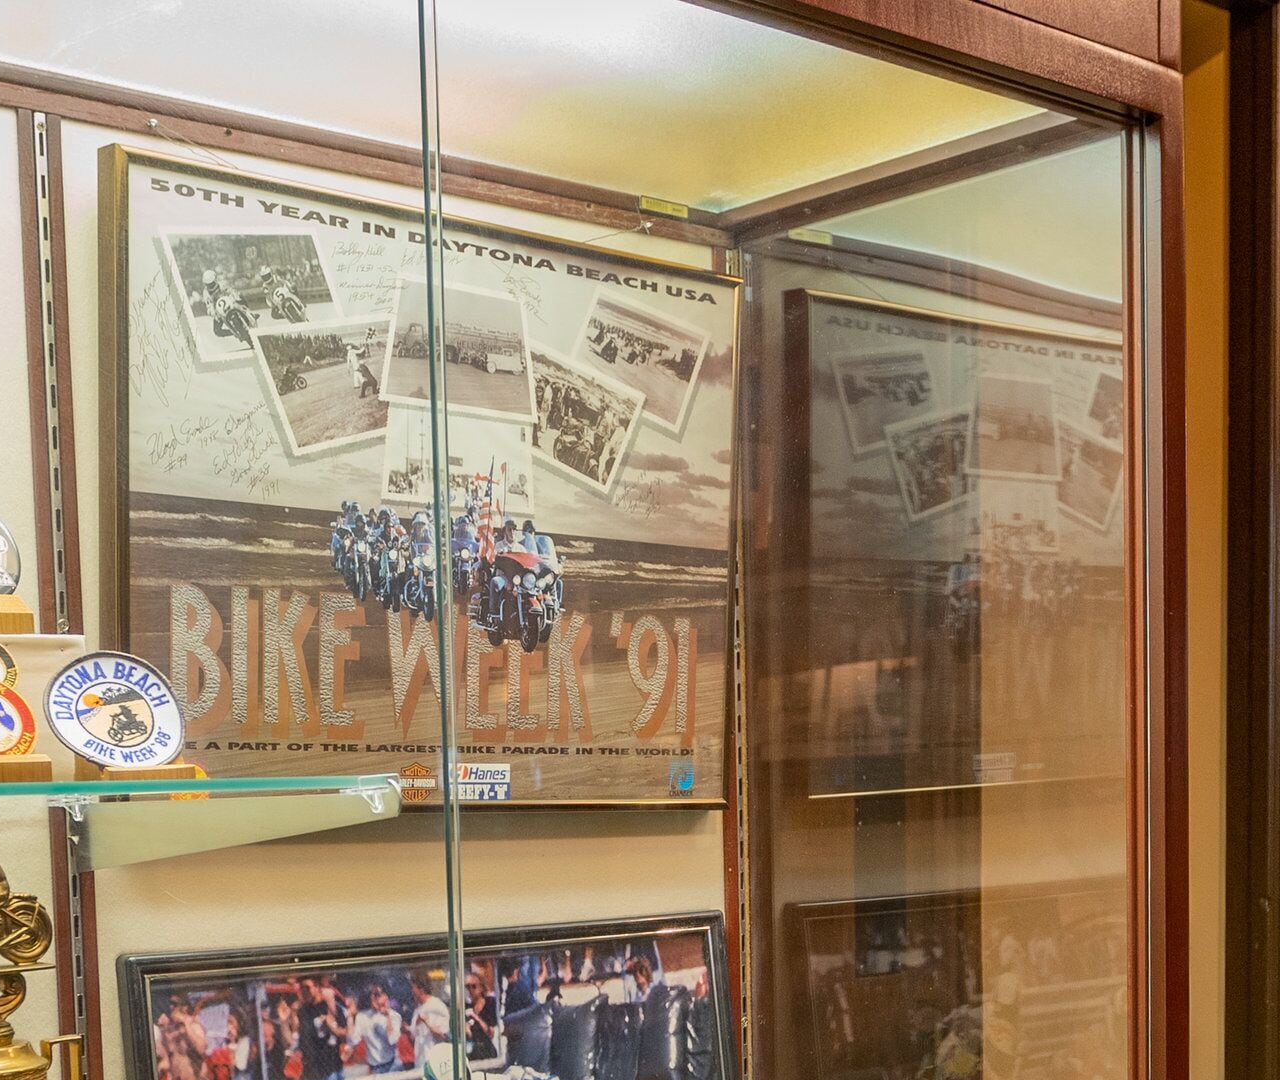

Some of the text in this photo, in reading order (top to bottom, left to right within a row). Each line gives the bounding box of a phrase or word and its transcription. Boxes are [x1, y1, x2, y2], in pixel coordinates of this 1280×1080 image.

[151, 178, 244, 208] 50TH
[257, 200, 349, 229] YEAR
[362, 222, 396, 238] IN
[408, 231, 556, 272] DAYTONA
[566, 263, 658, 292] BEACH
[666, 285, 717, 305] USA
[170, 584, 692, 734] BIKE WEEK '91
[56, 661, 171, 721] DAYTONA BEACH
[83, 738, 116, 760] BIKE
[120, 745, 158, 763] WEEK
[204, 741, 220, 750] A
[228, 742, 281, 751] PART
[287, 742, 315, 752] OF
[321, 743, 360, 752] THE
[366, 743, 442, 754] LARGEST
[456, 745, 495, 755] BIKE
[502, 746, 570, 755] PARADE
[575, 747, 593, 755] IN
[598, 747, 630, 756] THE
[468, 767, 506, 780] Hanes
